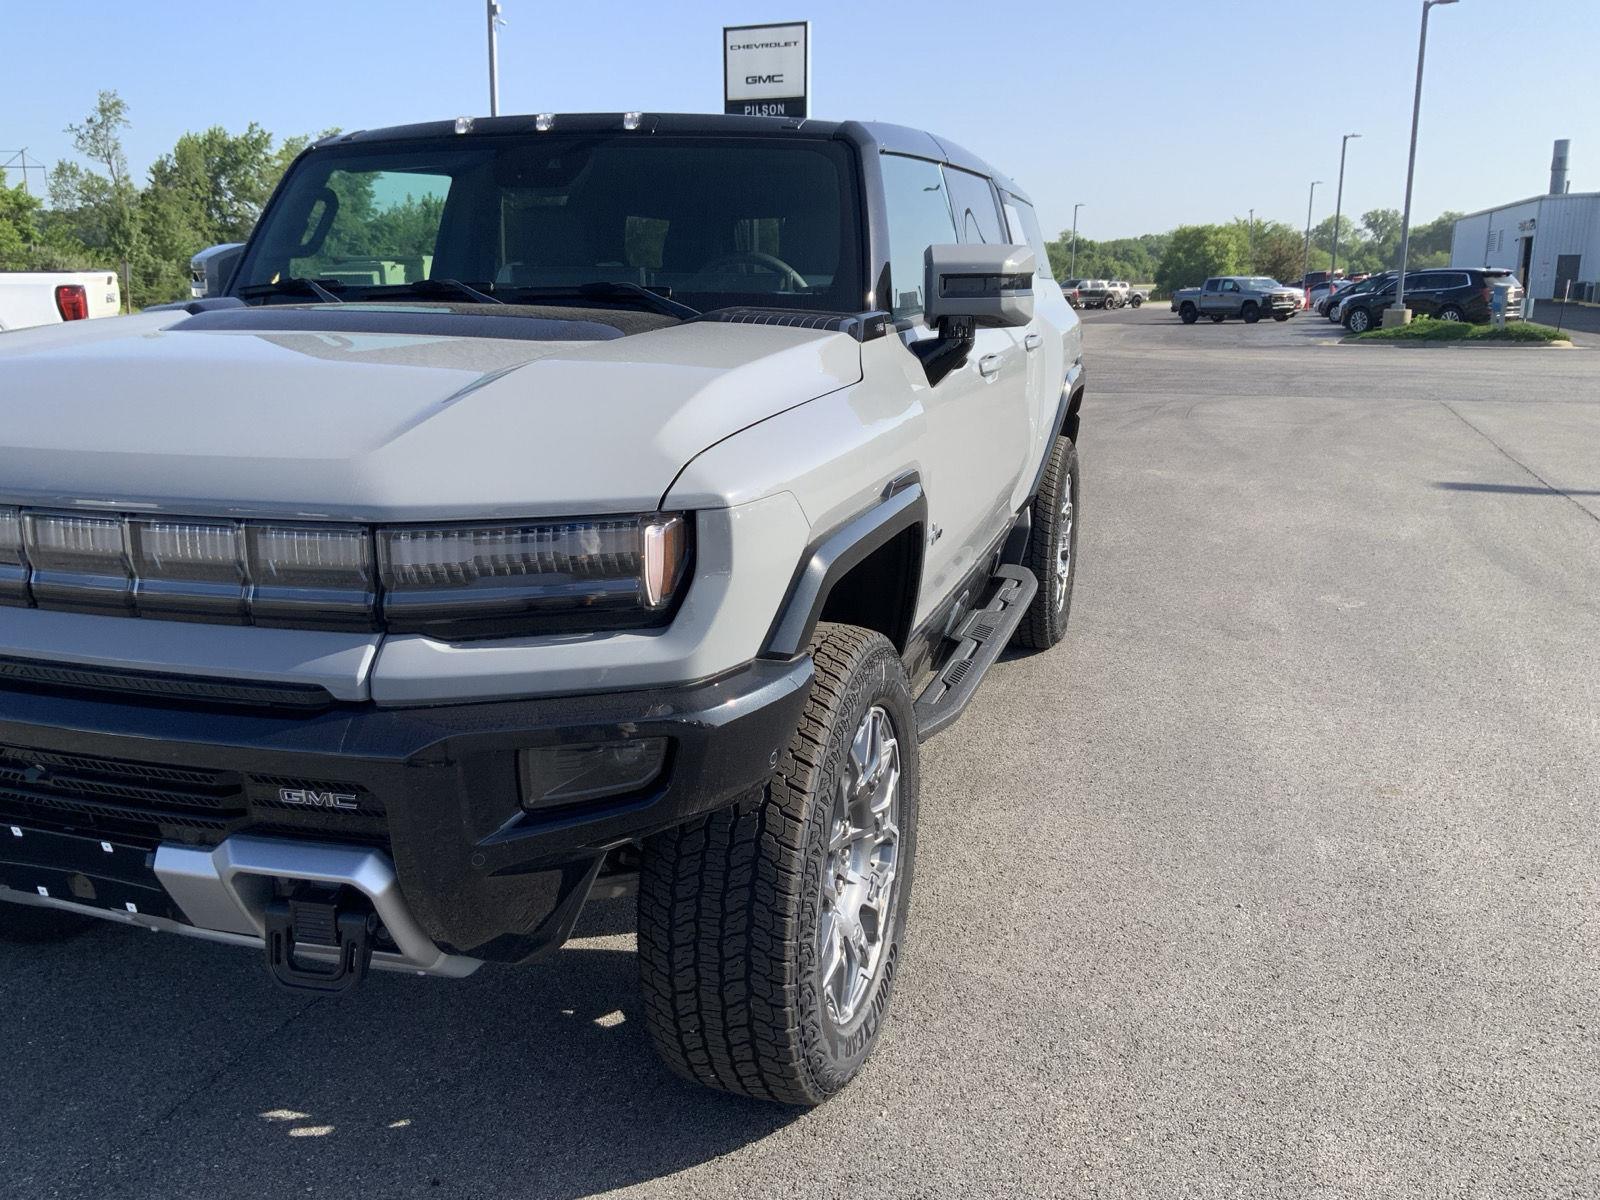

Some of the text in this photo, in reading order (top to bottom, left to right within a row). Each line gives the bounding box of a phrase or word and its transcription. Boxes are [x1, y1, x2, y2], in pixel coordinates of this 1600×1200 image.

[730, 41, 799, 51] CHEVROLET
[745, 74, 784, 85] GMC
[744, 104, 785, 116] PILSON
[279, 788, 358, 810] GMC
